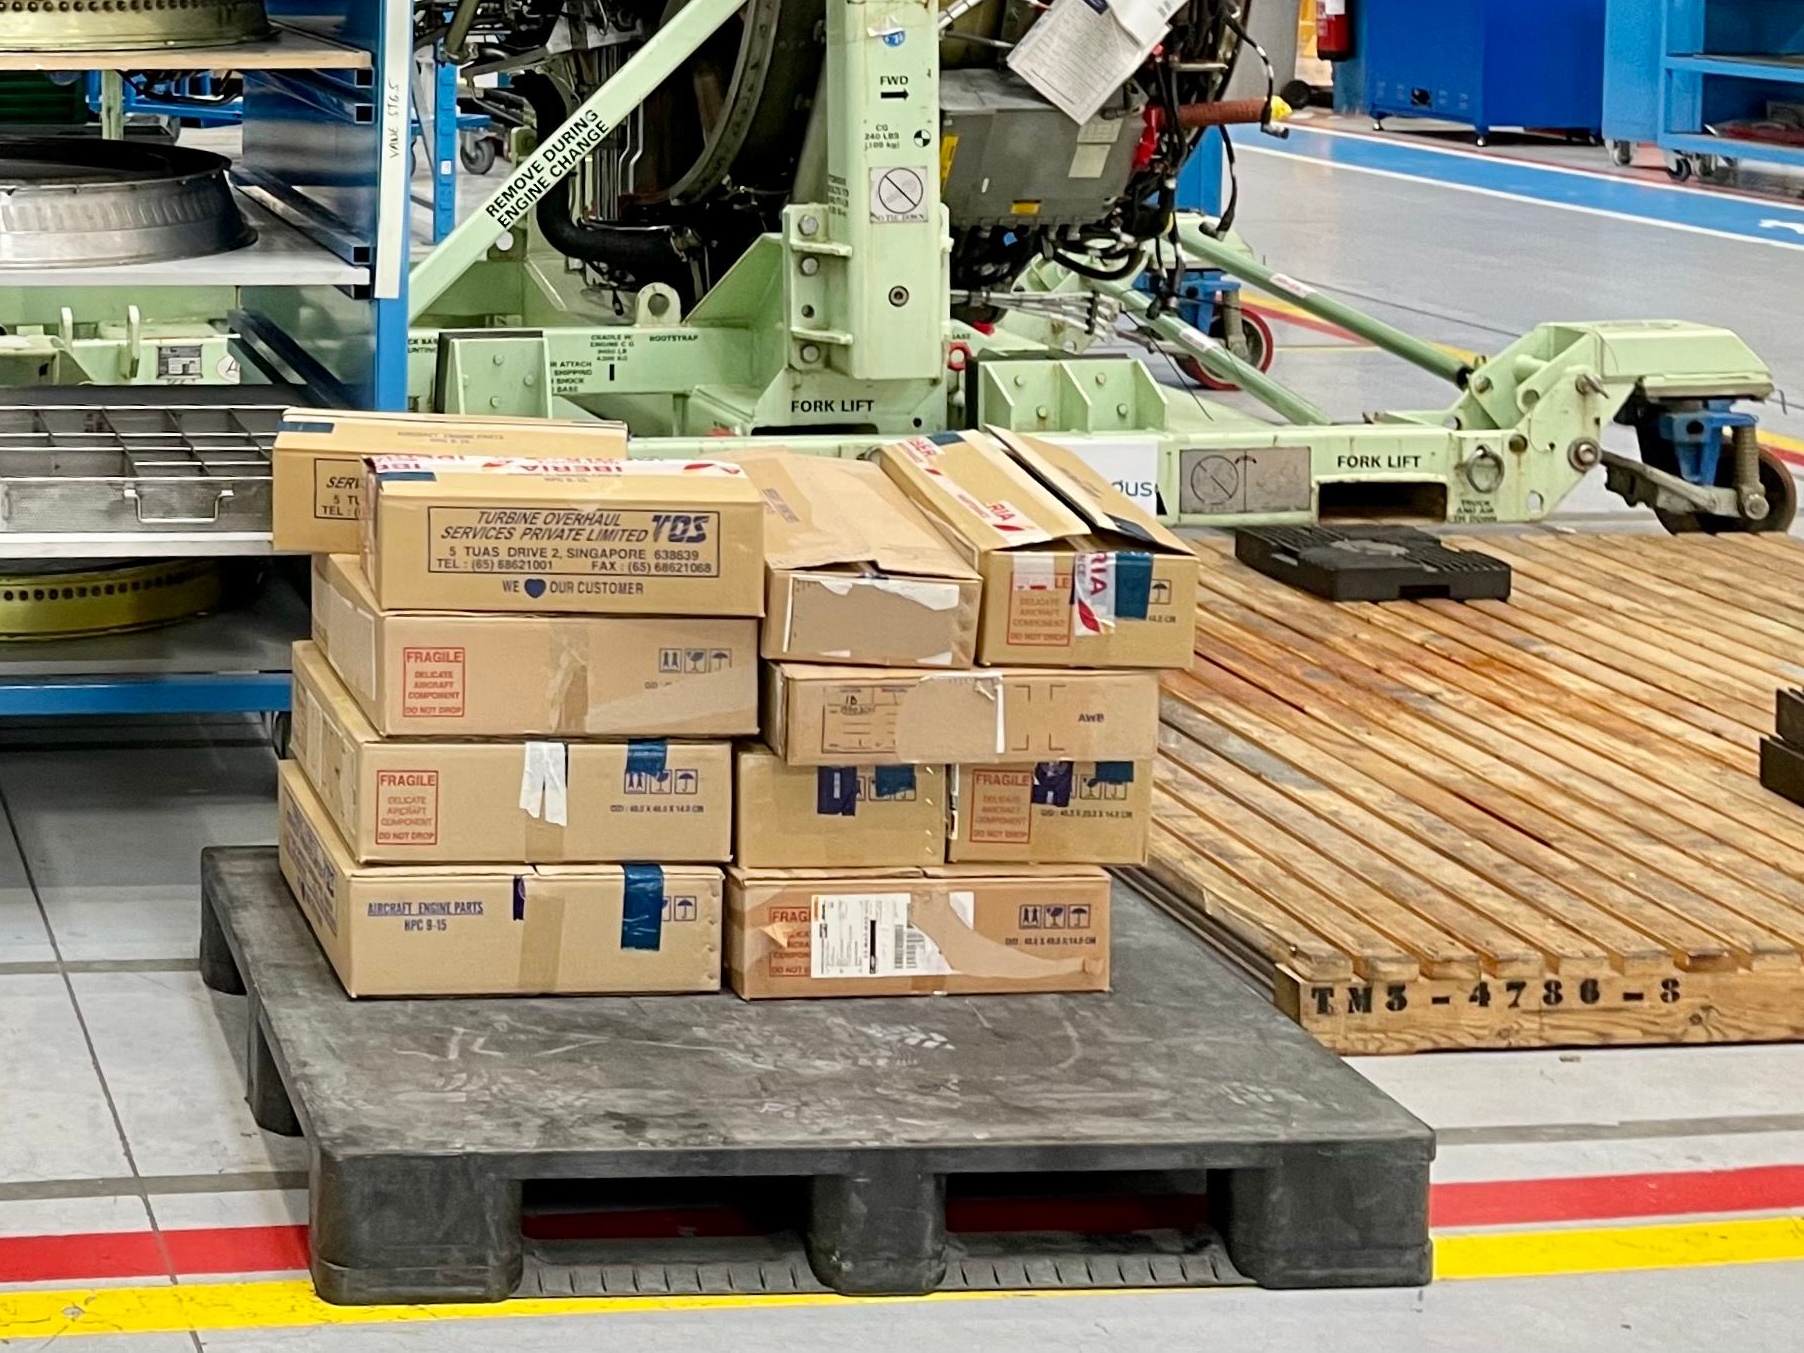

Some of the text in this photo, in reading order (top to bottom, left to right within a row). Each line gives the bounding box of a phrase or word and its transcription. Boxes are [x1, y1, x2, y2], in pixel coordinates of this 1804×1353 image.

[879, 75, 909, 86] FWD
[485, 109, 599, 217] REMOVE DURING
[497, 120, 609, 228] ENGINE CHANGE
[791, 399, 875, 413] FORK LIFT
[1337, 455, 1422, 468] FORK LIFT
[322, 505, 343, 515] TEL
[477, 511, 540, 526] TURBINE
[543, 512, 621, 527] OVERHAUL
[441, 525, 649, 543] SERVICES PRIVATE LIMITED
[449, 546, 457, 557] 5
[464, 547, 500, 558] TUAS
[507, 547, 547, 558] DRIVE
[566, 548, 646, 560] SINGAPORE
[436, 558, 461, 570] TEL
[471, 558, 495, 572] (65)
[497, 559, 553, 571] 68621001
[591, 560, 616, 571] FAX
[627, 561, 651, 574] (65)
[654, 562, 712, 573] 68621068
[502, 580, 644, 595] WE OUR CUSTOMER
[406, 651, 462, 663] FRAGILE
[380, 775, 436, 787] FRAGILE
[976, 774, 1030, 786] FRAGILE
[368, 902, 484, 916] AIRCRAFT ENGINE PARTS
